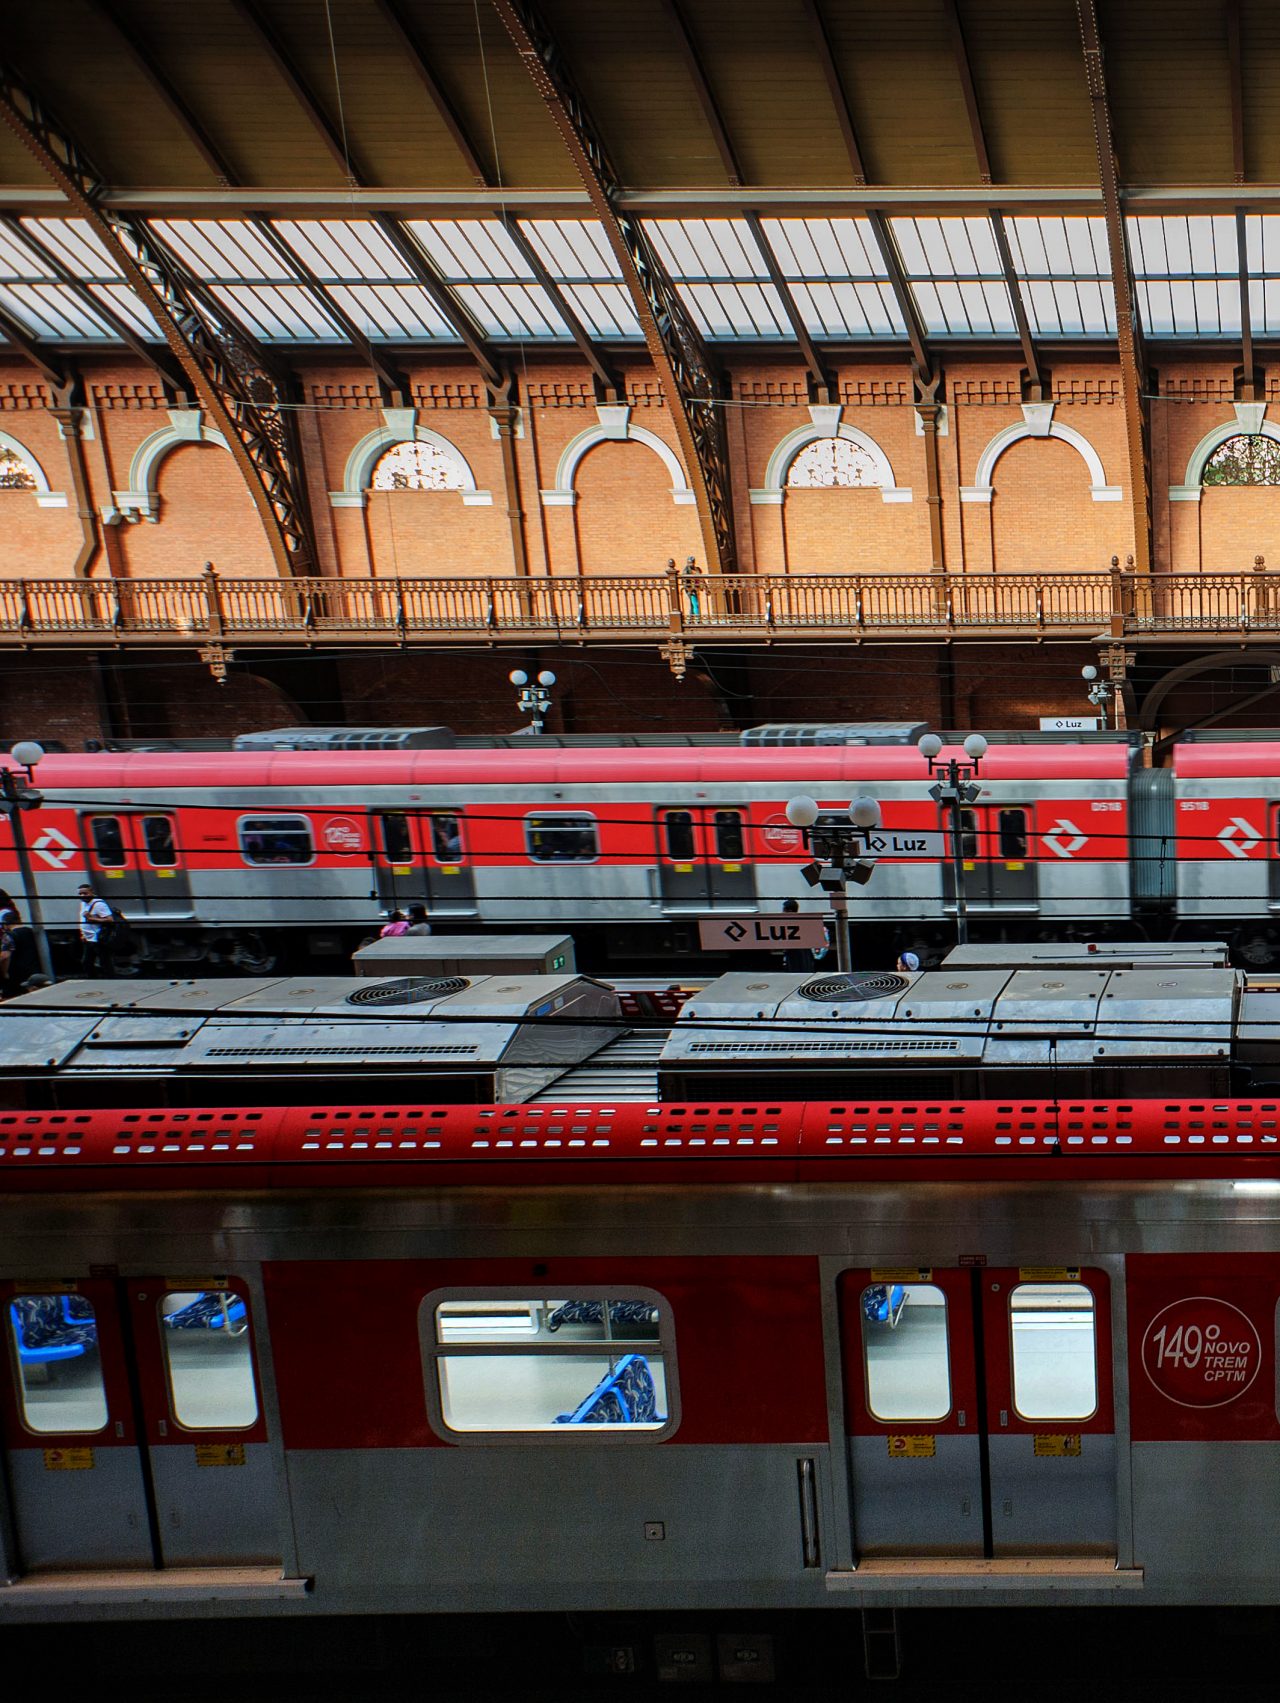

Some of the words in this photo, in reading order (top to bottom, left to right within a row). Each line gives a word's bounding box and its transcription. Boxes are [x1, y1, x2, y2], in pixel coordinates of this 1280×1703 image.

[1065, 720, 1082, 728] Luz
[893, 836, 927, 851] Luz
[755, 921, 801, 941] Luz
[1204, 1342, 1251, 1354] NOVO
[1204, 1356, 1248, 1369] TREM
[1204, 1370, 1246, 1382] CPTM
